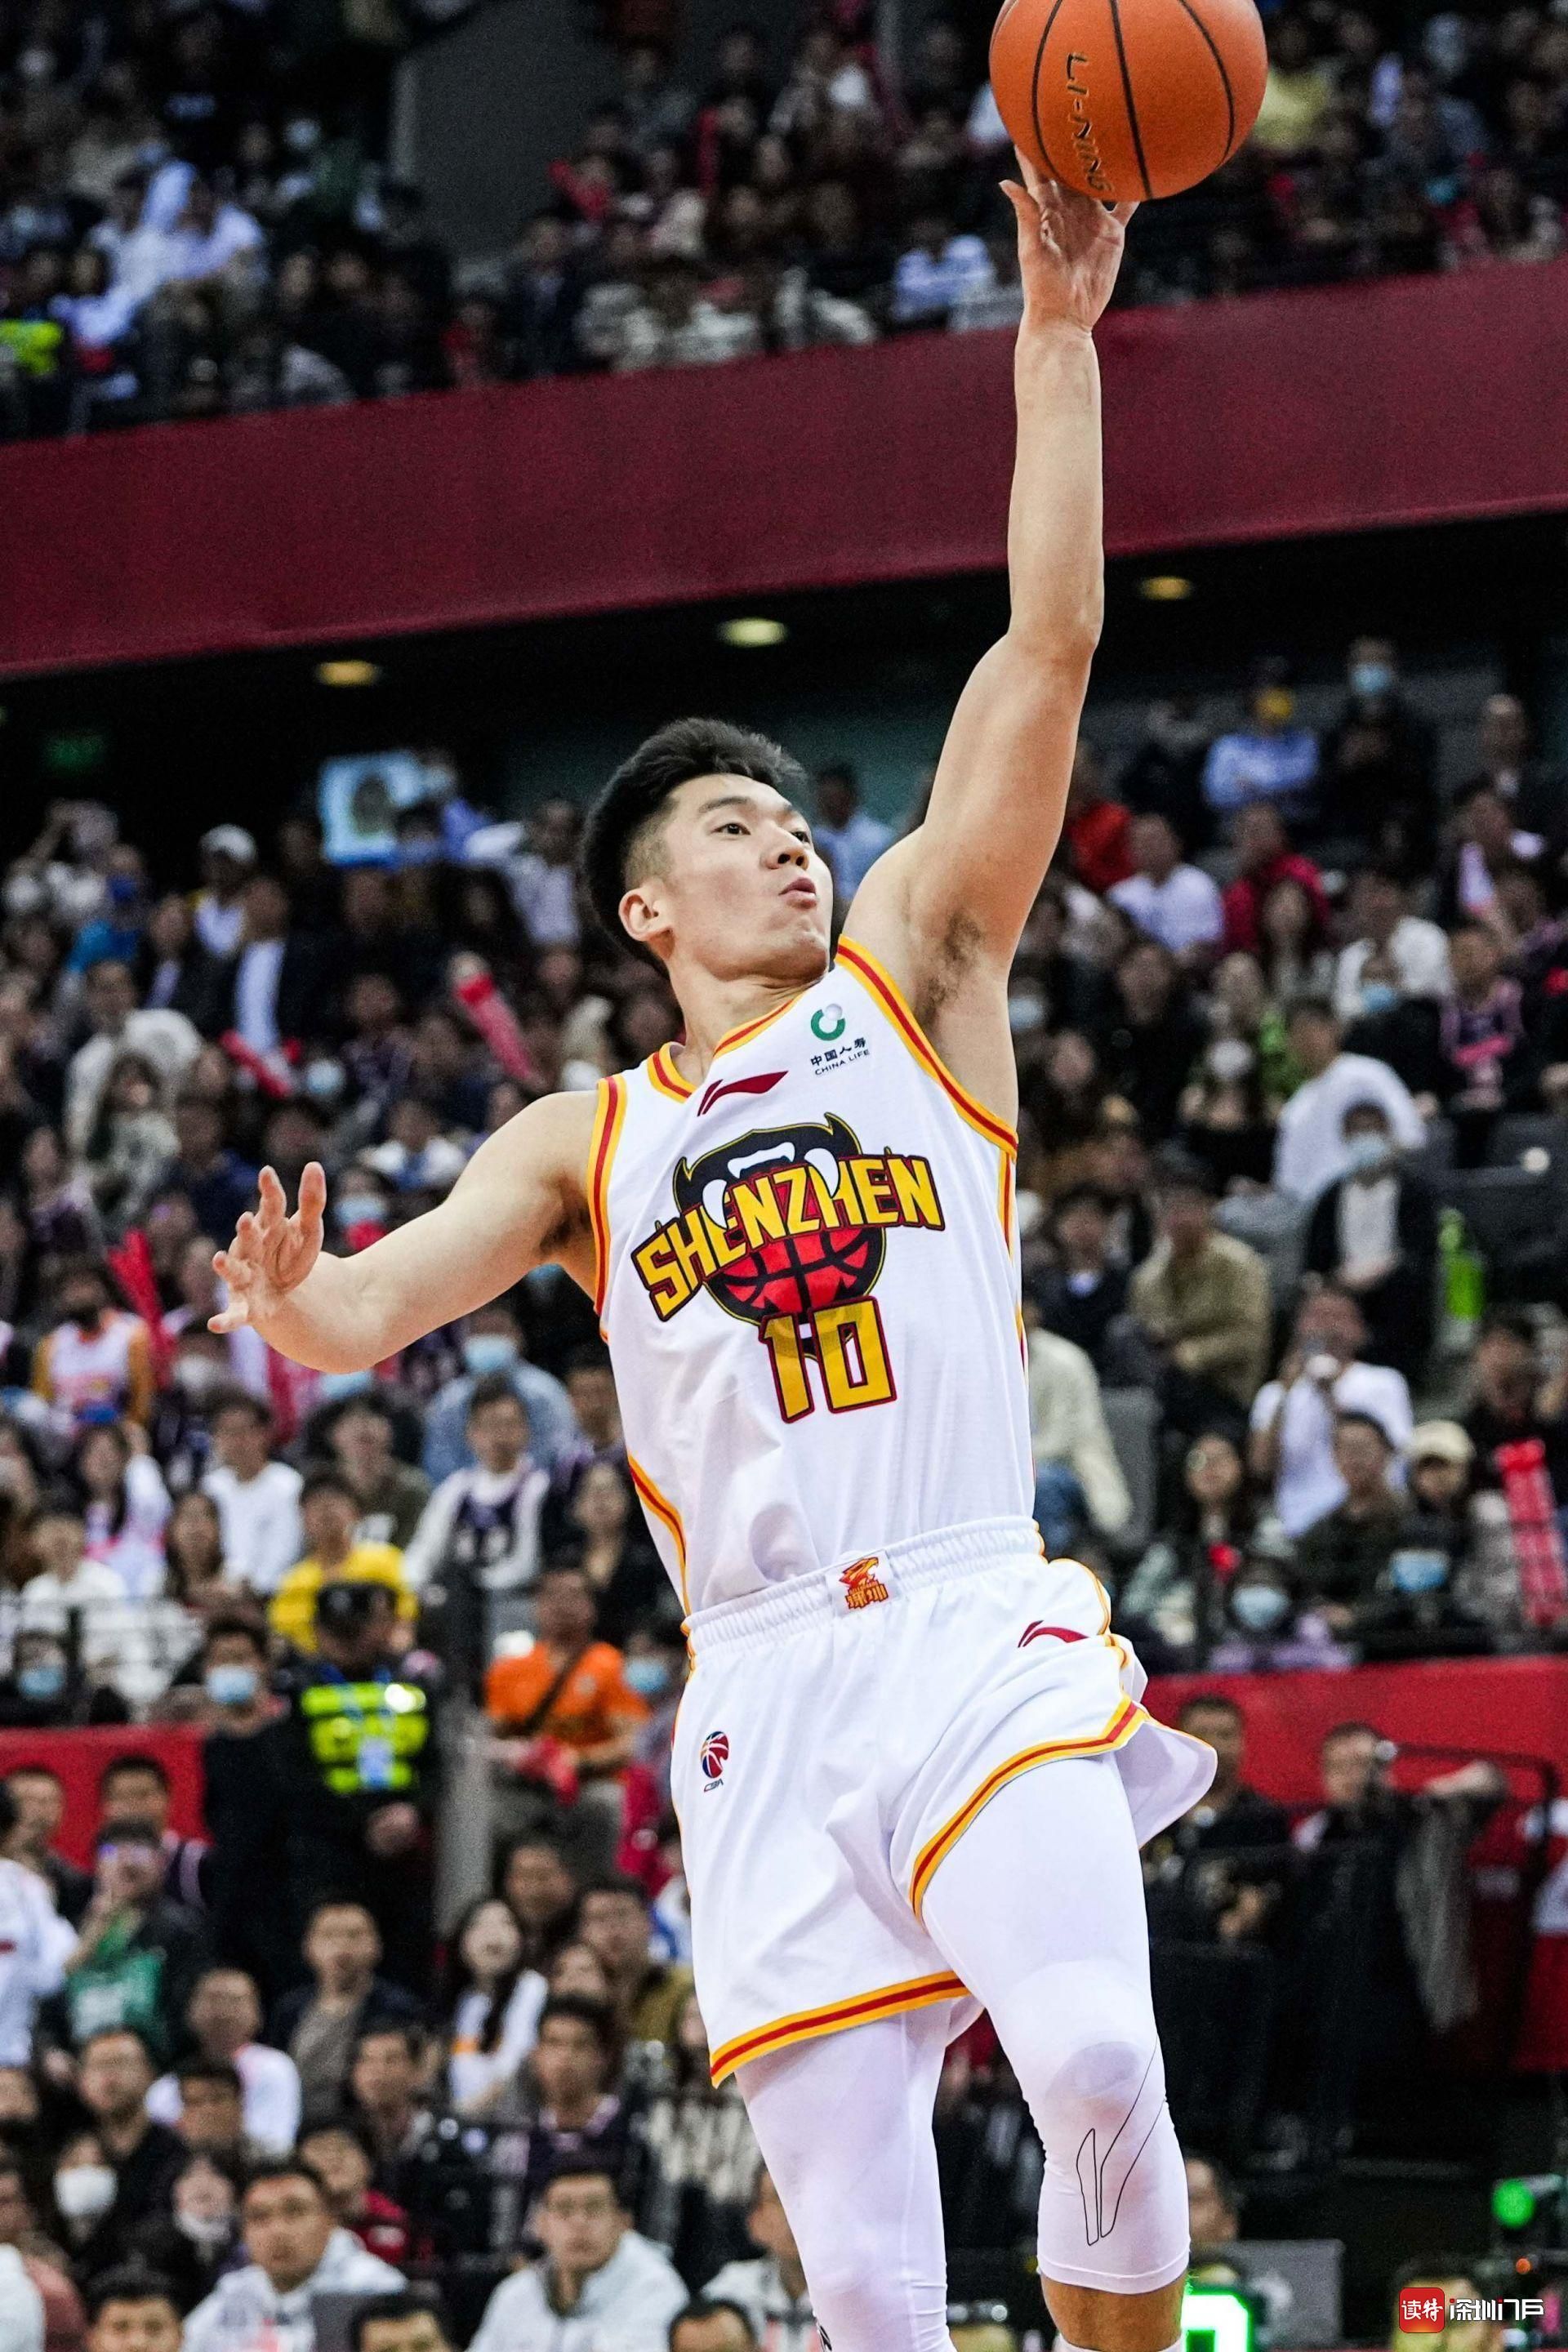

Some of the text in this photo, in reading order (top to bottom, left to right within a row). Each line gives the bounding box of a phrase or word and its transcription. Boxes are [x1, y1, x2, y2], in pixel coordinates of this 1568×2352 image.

[1066, 52, 1114, 193] LI-NING
[810, 1036, 866, 1067] 中国人寿
[815, 1049, 870, 1076] CHINA LIFE
[631, 1155, 945, 1321] SHENZHEN
[759, 1295, 897, 1423] 10
